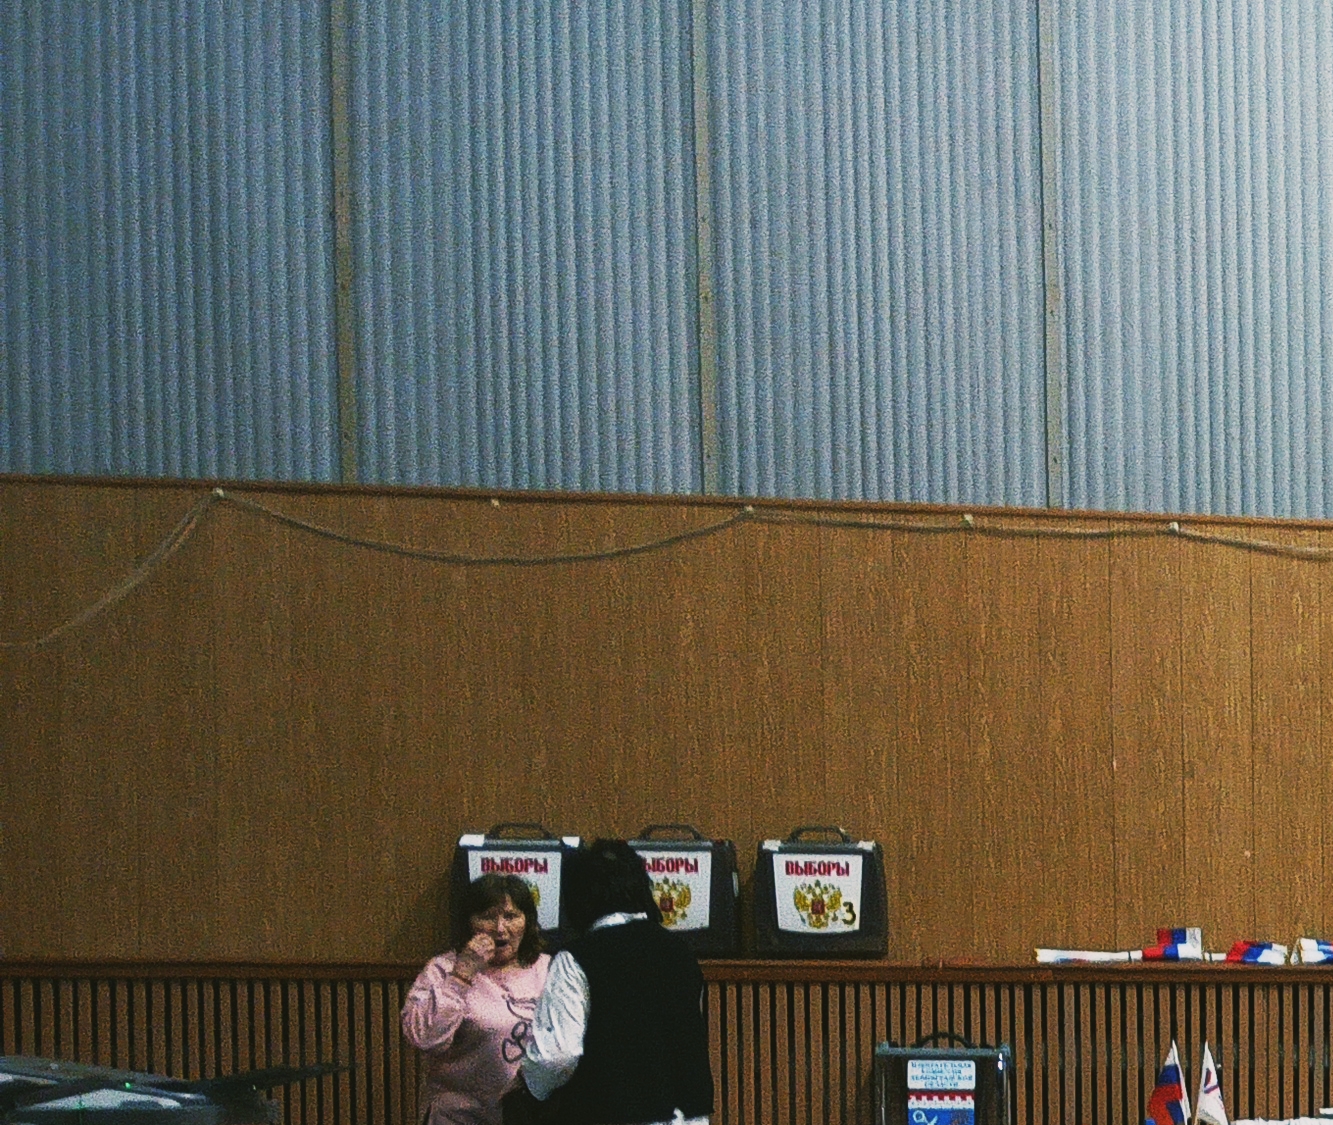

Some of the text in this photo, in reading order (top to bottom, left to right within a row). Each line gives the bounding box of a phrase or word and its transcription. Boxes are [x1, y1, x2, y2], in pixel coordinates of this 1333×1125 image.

[481, 857, 548, 874] ВЫБОРЫ
[643, 857, 699, 874] ЫБОРЫ
[785, 860, 850, 877] ВЫБОРЫ
[842, 901, 856, 925] 3
